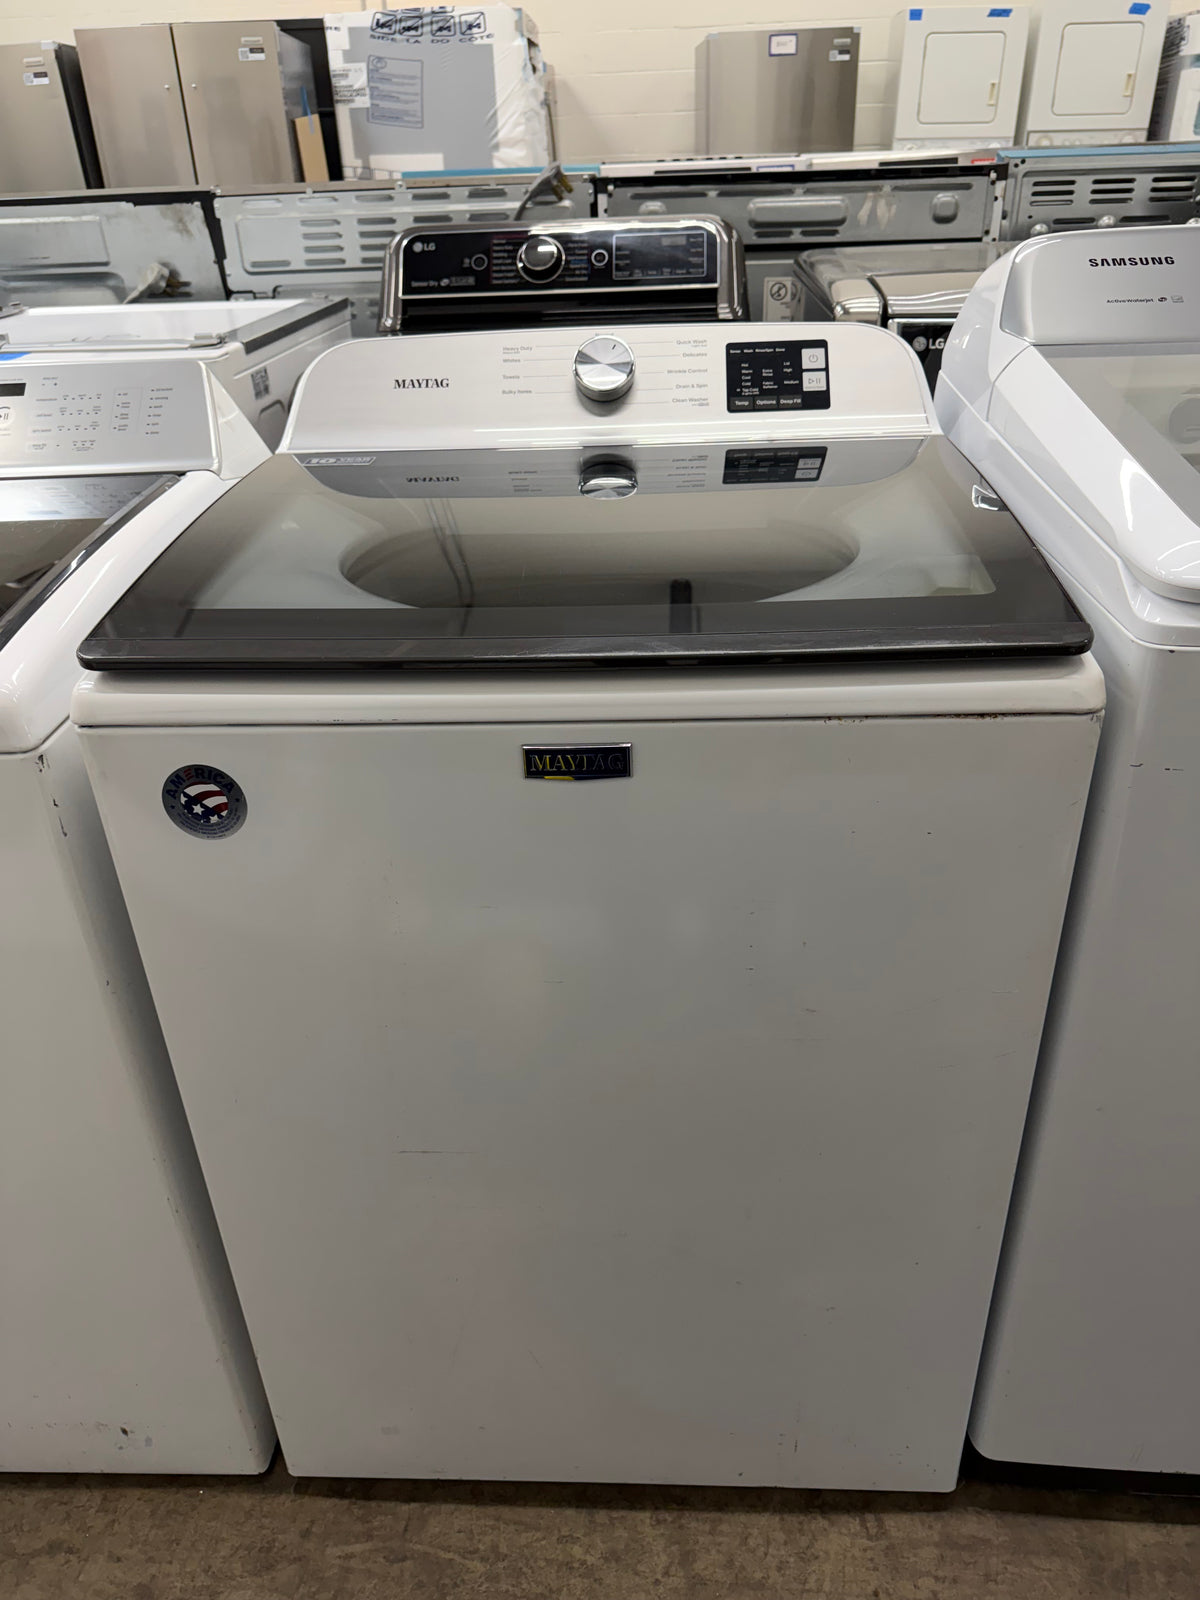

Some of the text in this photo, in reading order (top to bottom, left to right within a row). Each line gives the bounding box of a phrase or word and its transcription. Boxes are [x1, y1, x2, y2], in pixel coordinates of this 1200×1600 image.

[424, 242, 436, 251] LG
[1088, 256, 1175, 267] SAMSUNG
[928, 337, 945, 350] LG
[393, 378, 450, 389] MAYTAG
[529, 753, 625, 772] MAYTAG
[165, 767, 236, 801] AMERICA
